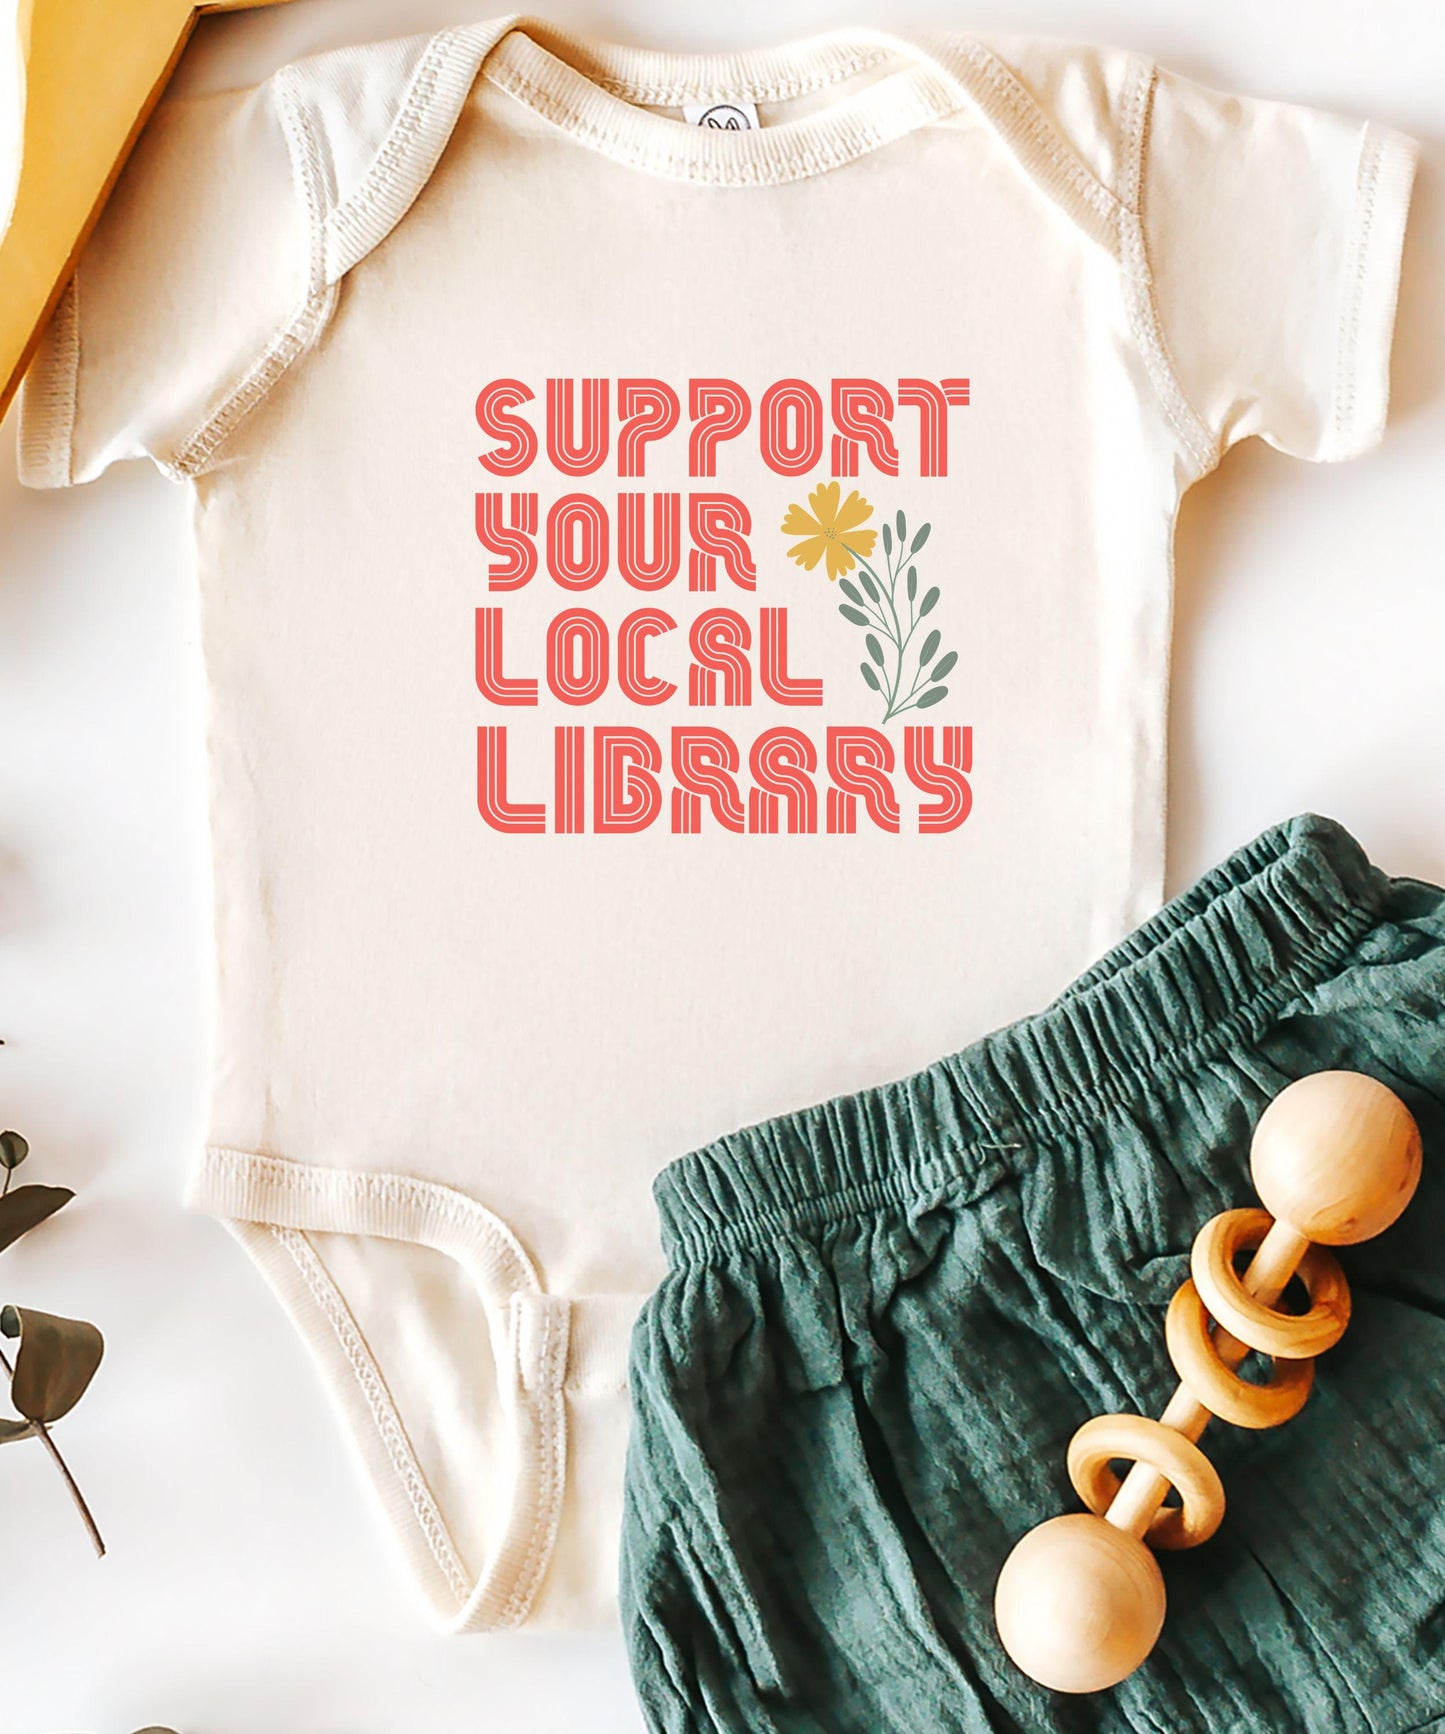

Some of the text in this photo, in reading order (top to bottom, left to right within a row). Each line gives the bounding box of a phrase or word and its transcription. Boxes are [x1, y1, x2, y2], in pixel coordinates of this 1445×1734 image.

[475, 378, 970, 477] SUPPORT
[475, 493, 756, 591] YOUR
[475, 608, 823, 706] LOCAL
[477, 726, 972, 834] LIBRARY
